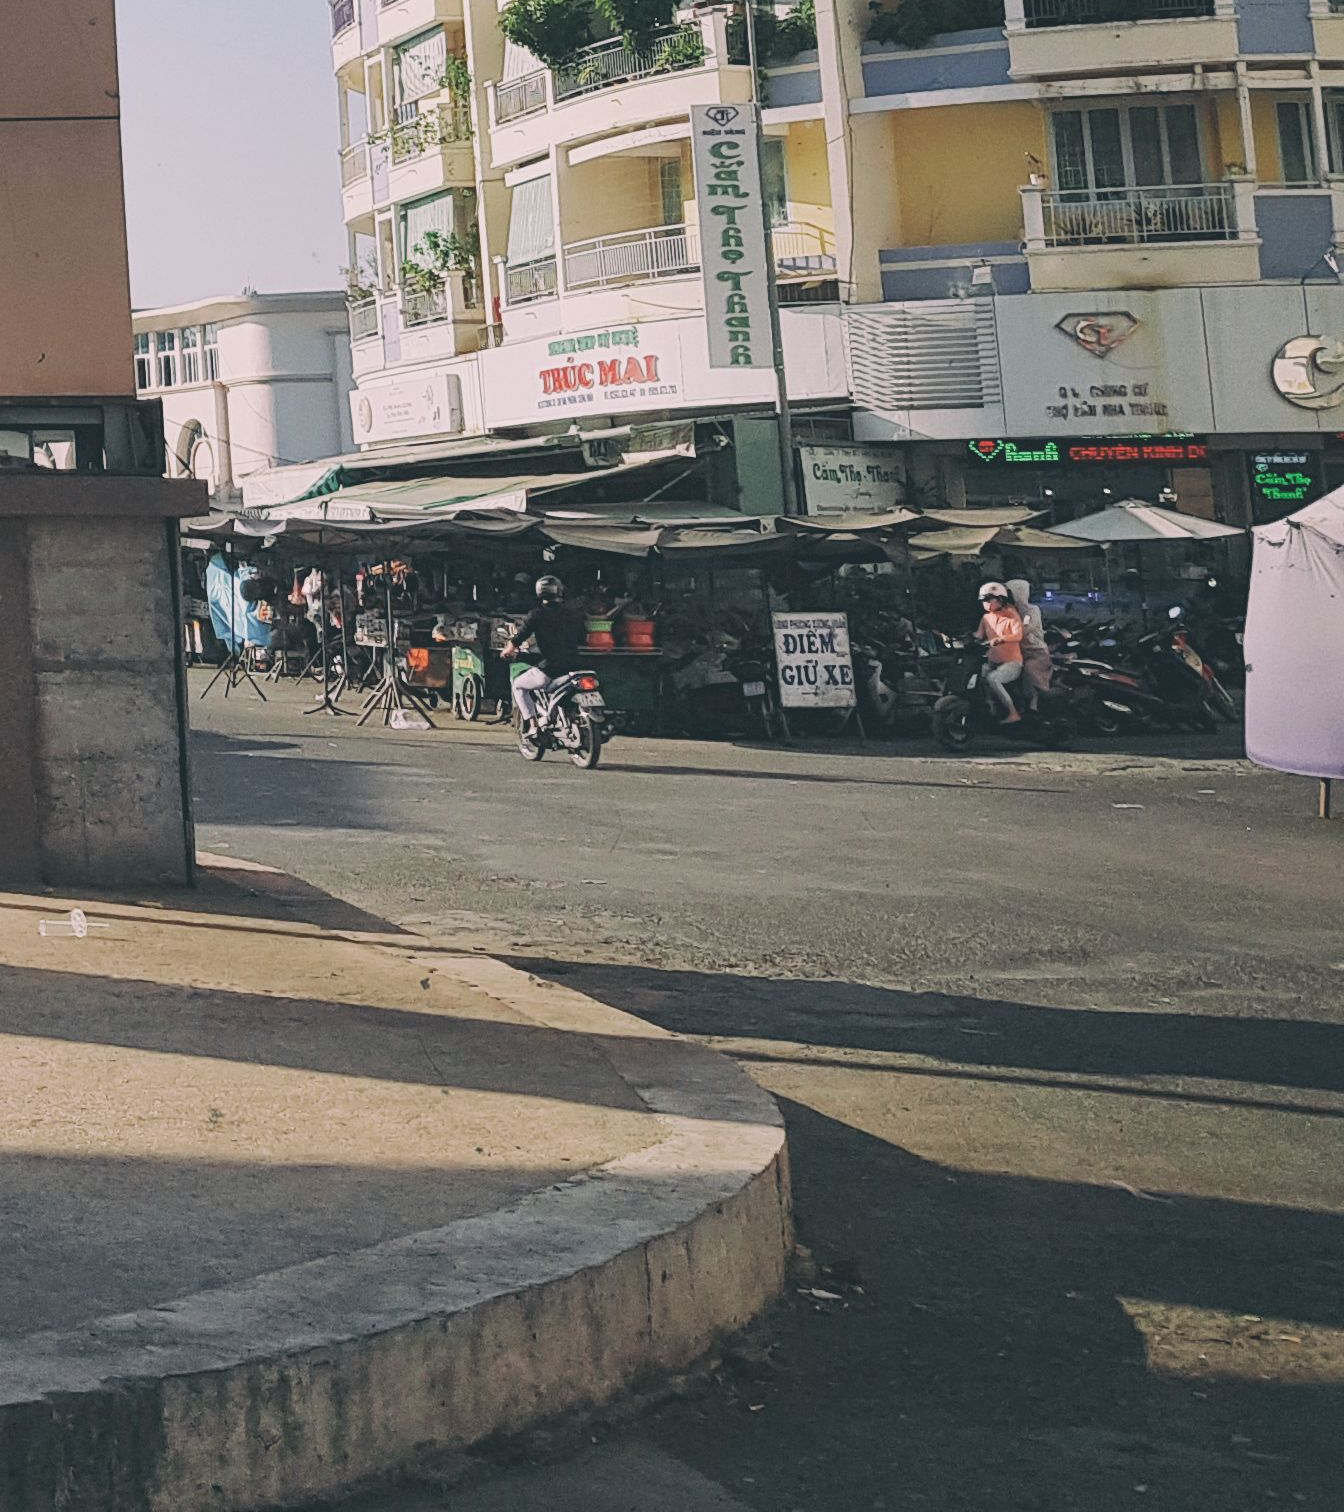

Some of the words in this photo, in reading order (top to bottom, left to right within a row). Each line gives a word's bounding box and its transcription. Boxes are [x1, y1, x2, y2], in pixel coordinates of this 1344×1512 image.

[539, 356, 595, 395] TRÚC
[598, 355, 660, 387] MAI
[781, 659, 819, 685] GIỮ
[823, 664, 852, 686] XE
